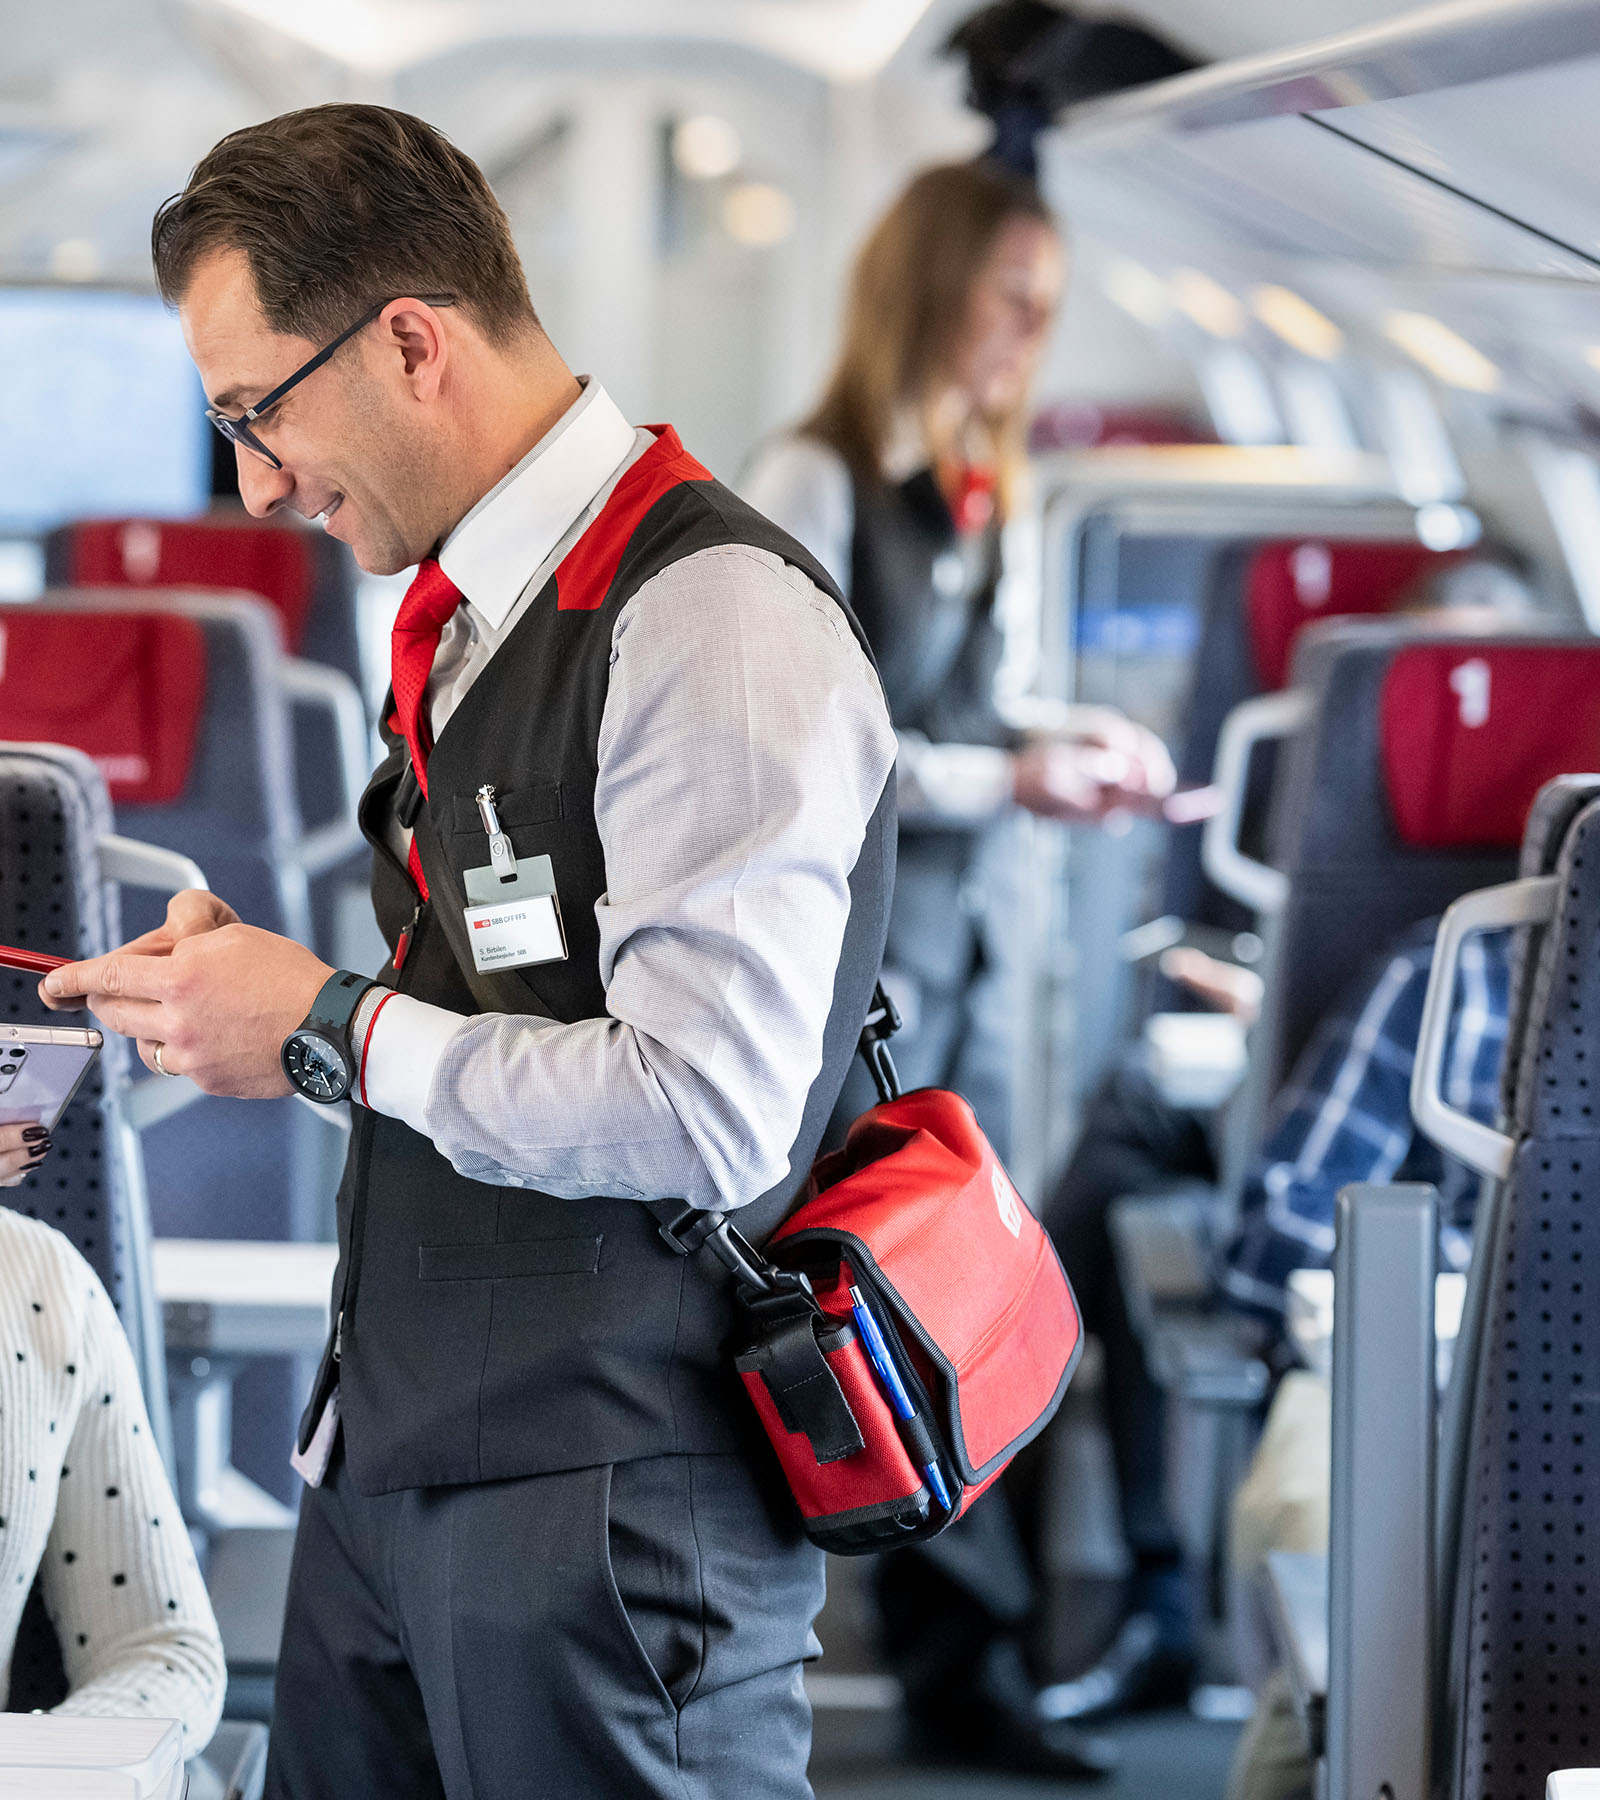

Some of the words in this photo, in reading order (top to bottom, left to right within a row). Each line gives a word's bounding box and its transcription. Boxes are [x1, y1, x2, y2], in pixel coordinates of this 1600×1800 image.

[1451, 658, 1491, 727] 1
[491, 917, 504, 926] SBB
[504, 914, 515, 923] CFF
[515, 912, 527, 921] FFS
